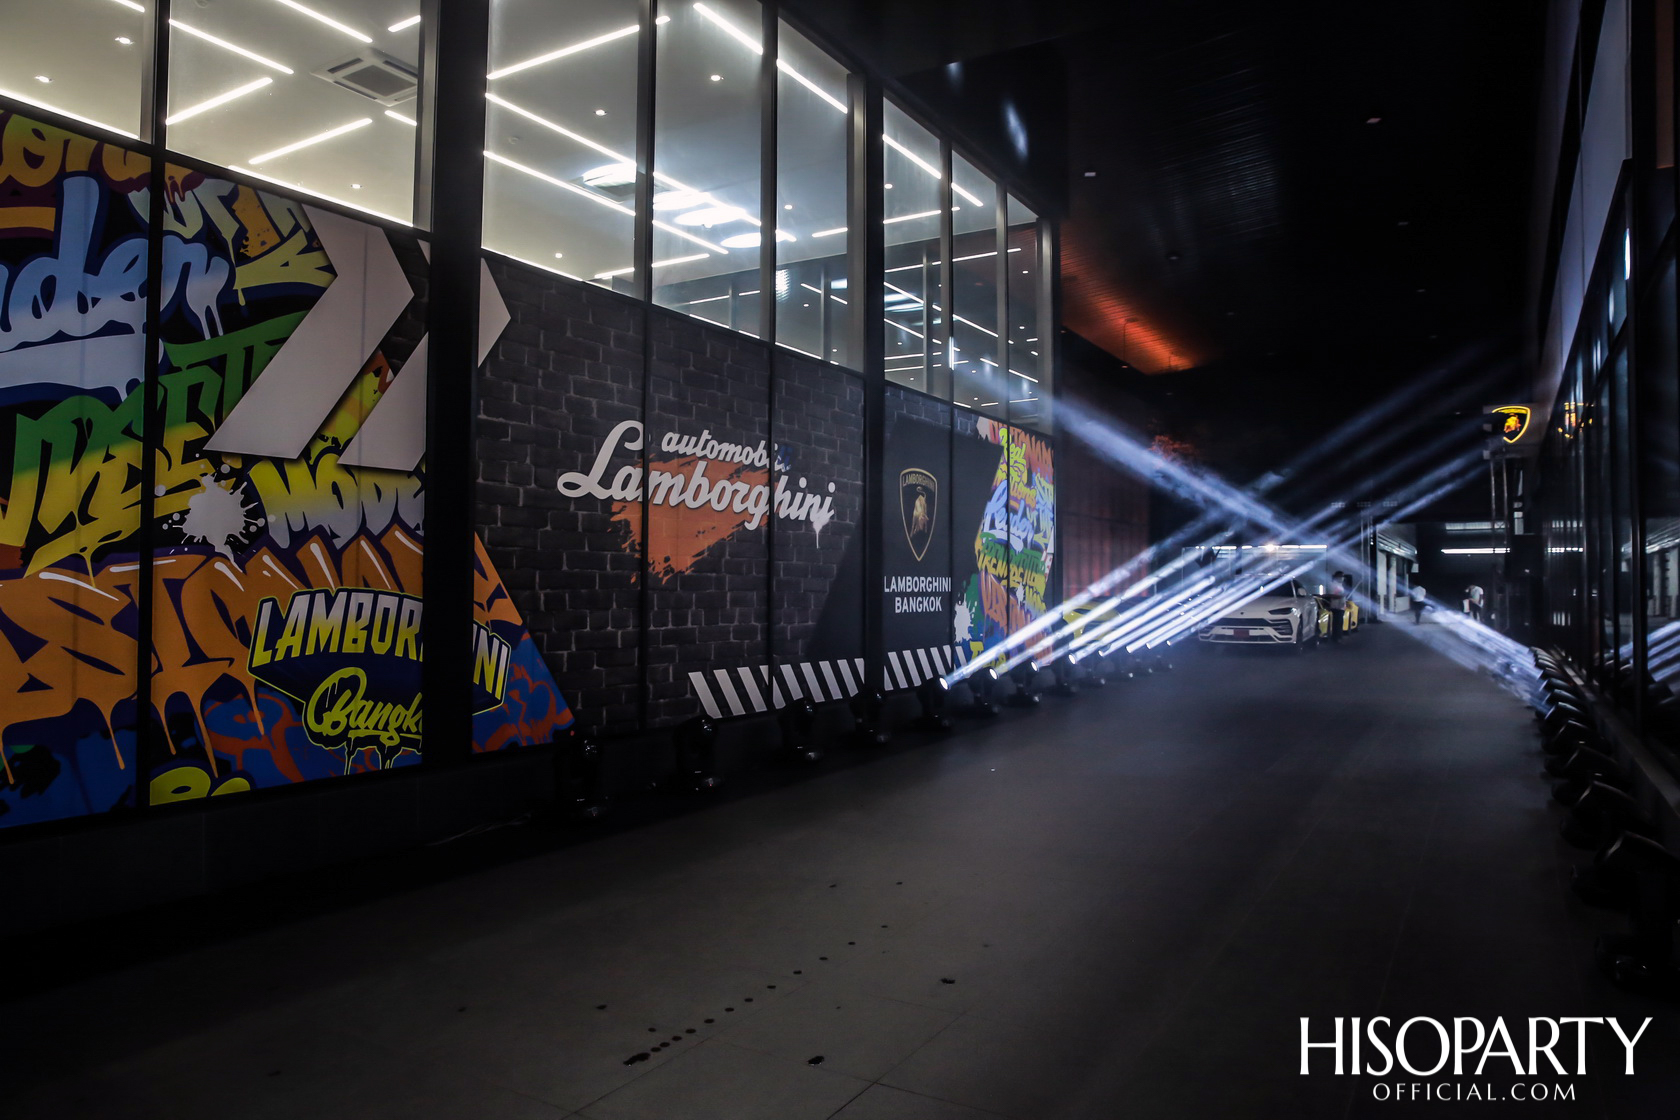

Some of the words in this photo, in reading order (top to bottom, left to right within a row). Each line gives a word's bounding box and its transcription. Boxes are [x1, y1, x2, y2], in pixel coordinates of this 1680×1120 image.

[557, 420, 835, 531] Lamborghini
[884, 575, 952, 593] LAMBORGHINI
[894, 596, 943, 614] BANGKOK
[251, 591, 510, 701] LAMBORNI
[306, 667, 423, 746] Bangk
